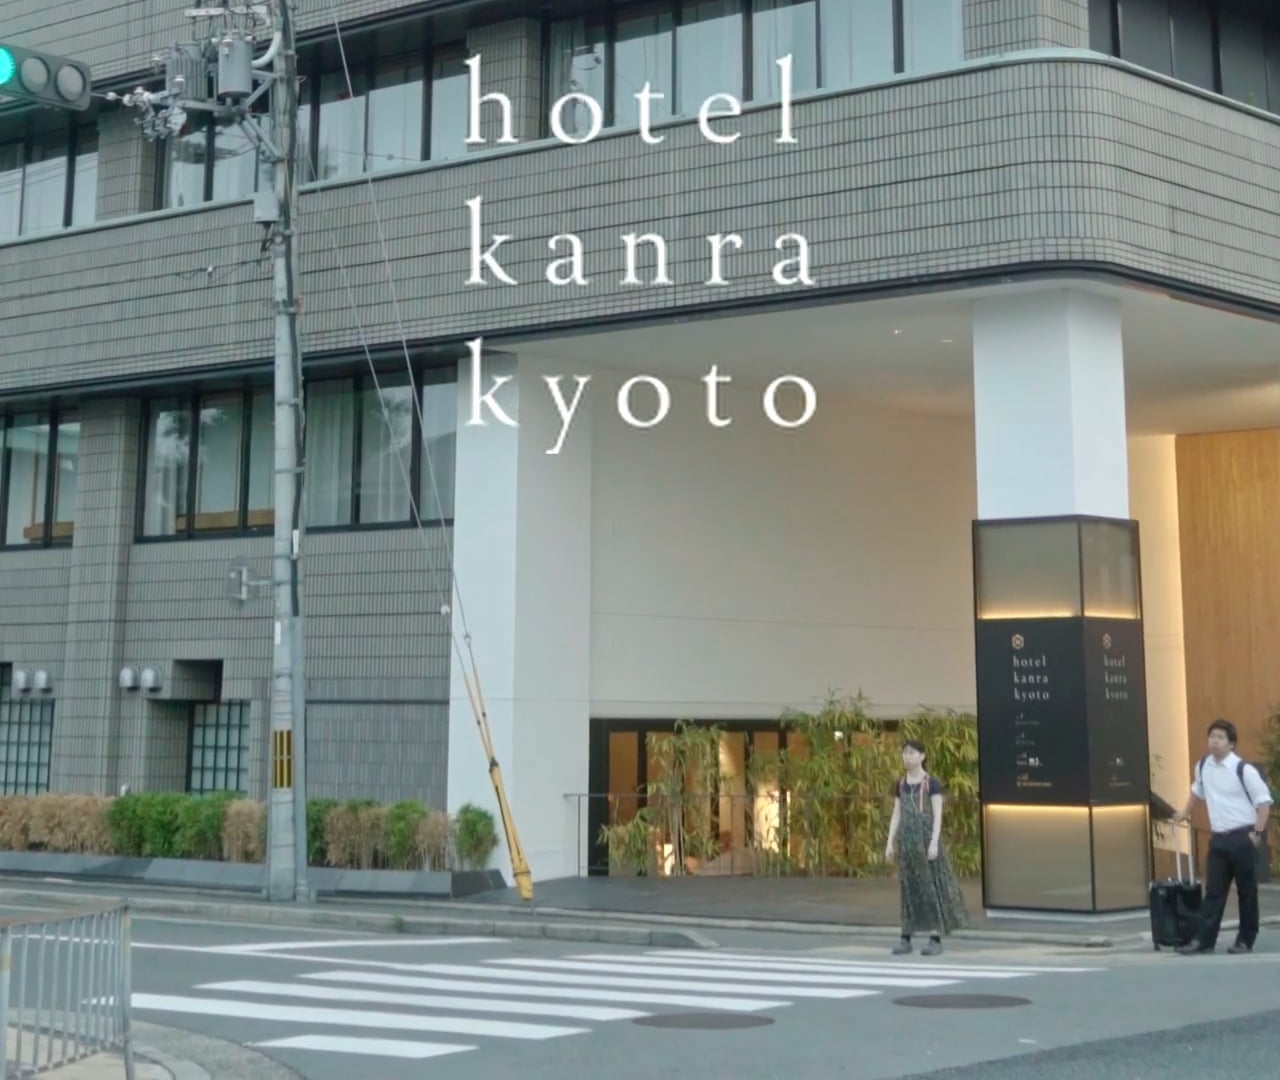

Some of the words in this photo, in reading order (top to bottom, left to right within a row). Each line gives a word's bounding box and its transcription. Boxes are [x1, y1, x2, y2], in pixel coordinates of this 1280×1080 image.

[1012, 654, 1047, 667] hotel
[1013, 671, 1049, 684] kanra
[1014, 687, 1050, 702] kyoto
